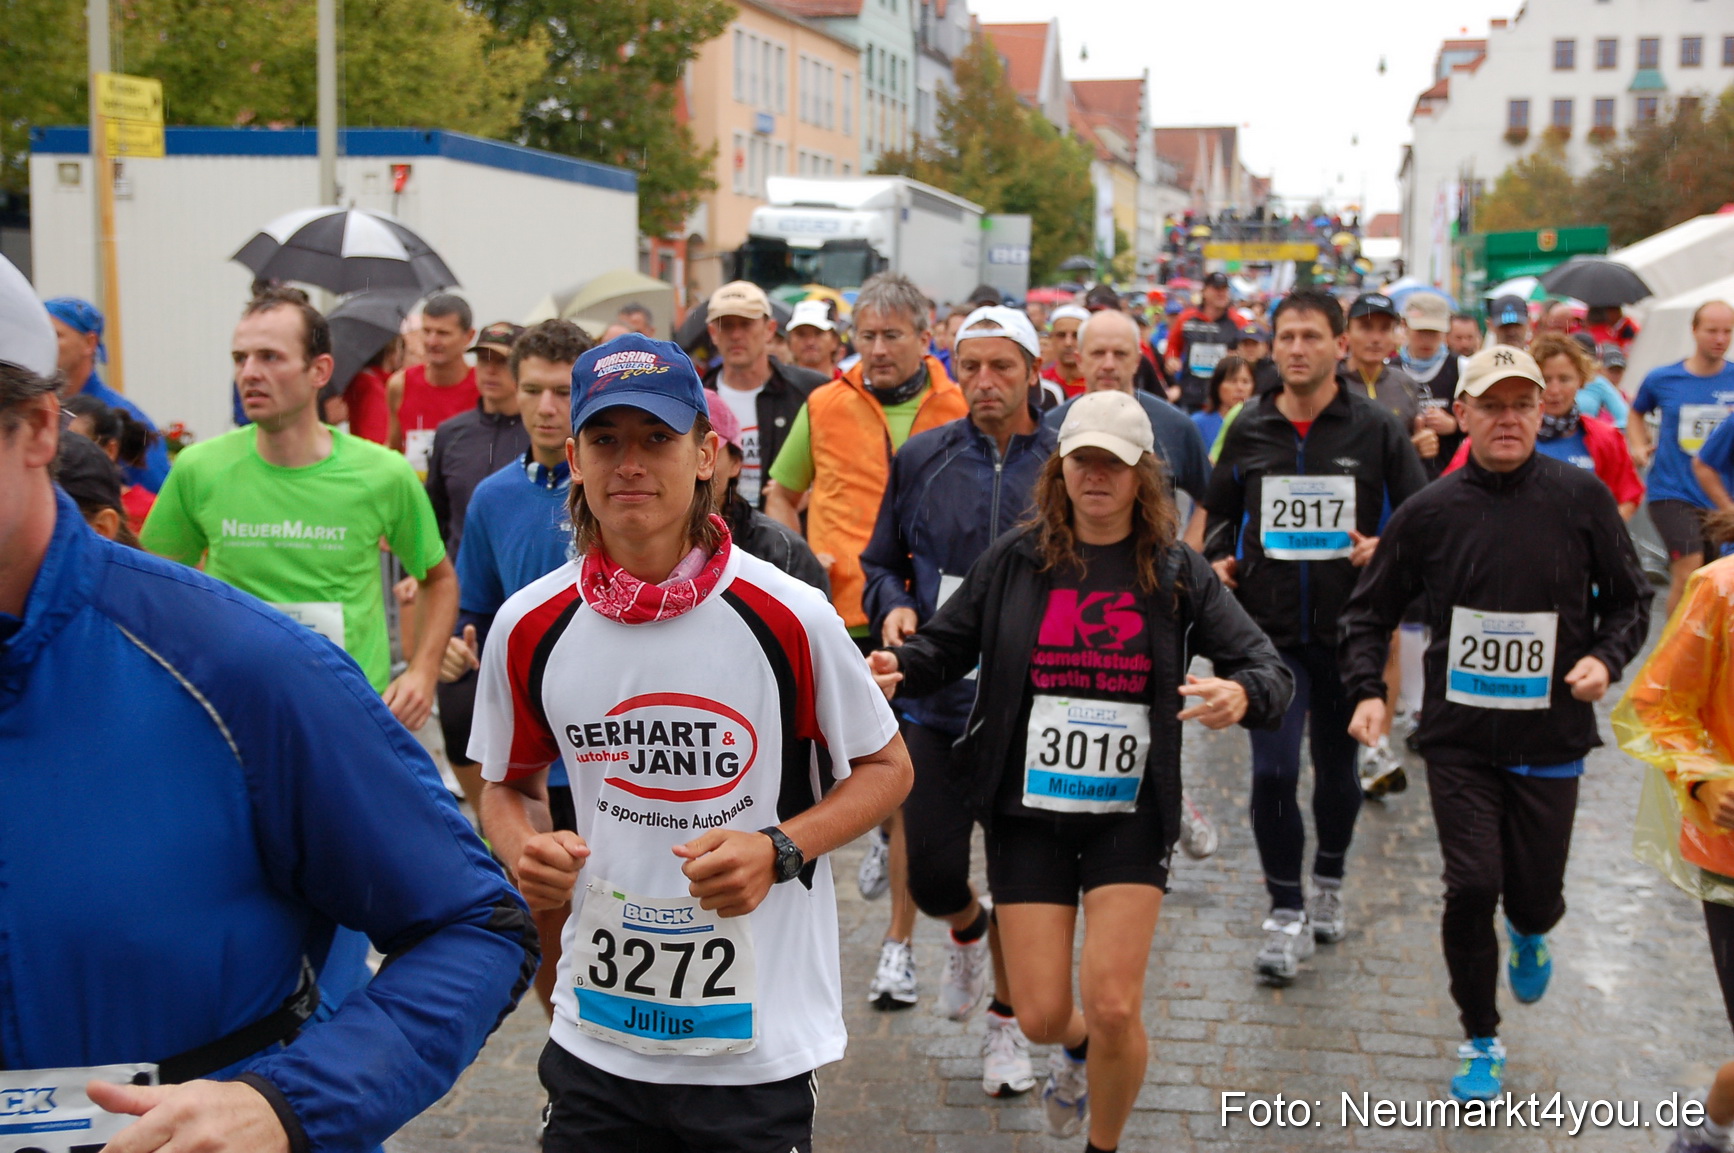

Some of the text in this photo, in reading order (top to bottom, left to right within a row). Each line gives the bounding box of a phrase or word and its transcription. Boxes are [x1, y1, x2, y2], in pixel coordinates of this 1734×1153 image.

[593, 351, 657, 372] NORISRING
[620, 366, 670, 380] 2005
[1272, 499, 1345, 528] 2917
[1288, 535, 1328, 547] Tobias
[1459, 635, 1544, 673] 2908
[1472, 677, 1527, 695] Thomas
[565, 720, 736, 749] GERHART &
[629, 748, 739, 778] JÄNIG
[1039, 727, 1138, 774] 3018
[1048, 777, 1118, 797] Michaela
[610, 803, 689, 830] sportliche
[692, 795, 754, 830] Autohaus
[623, 902, 695, 925] BOCK
[588, 928, 736, 999] 3272
[623, 1005, 695, 1035] Julius
